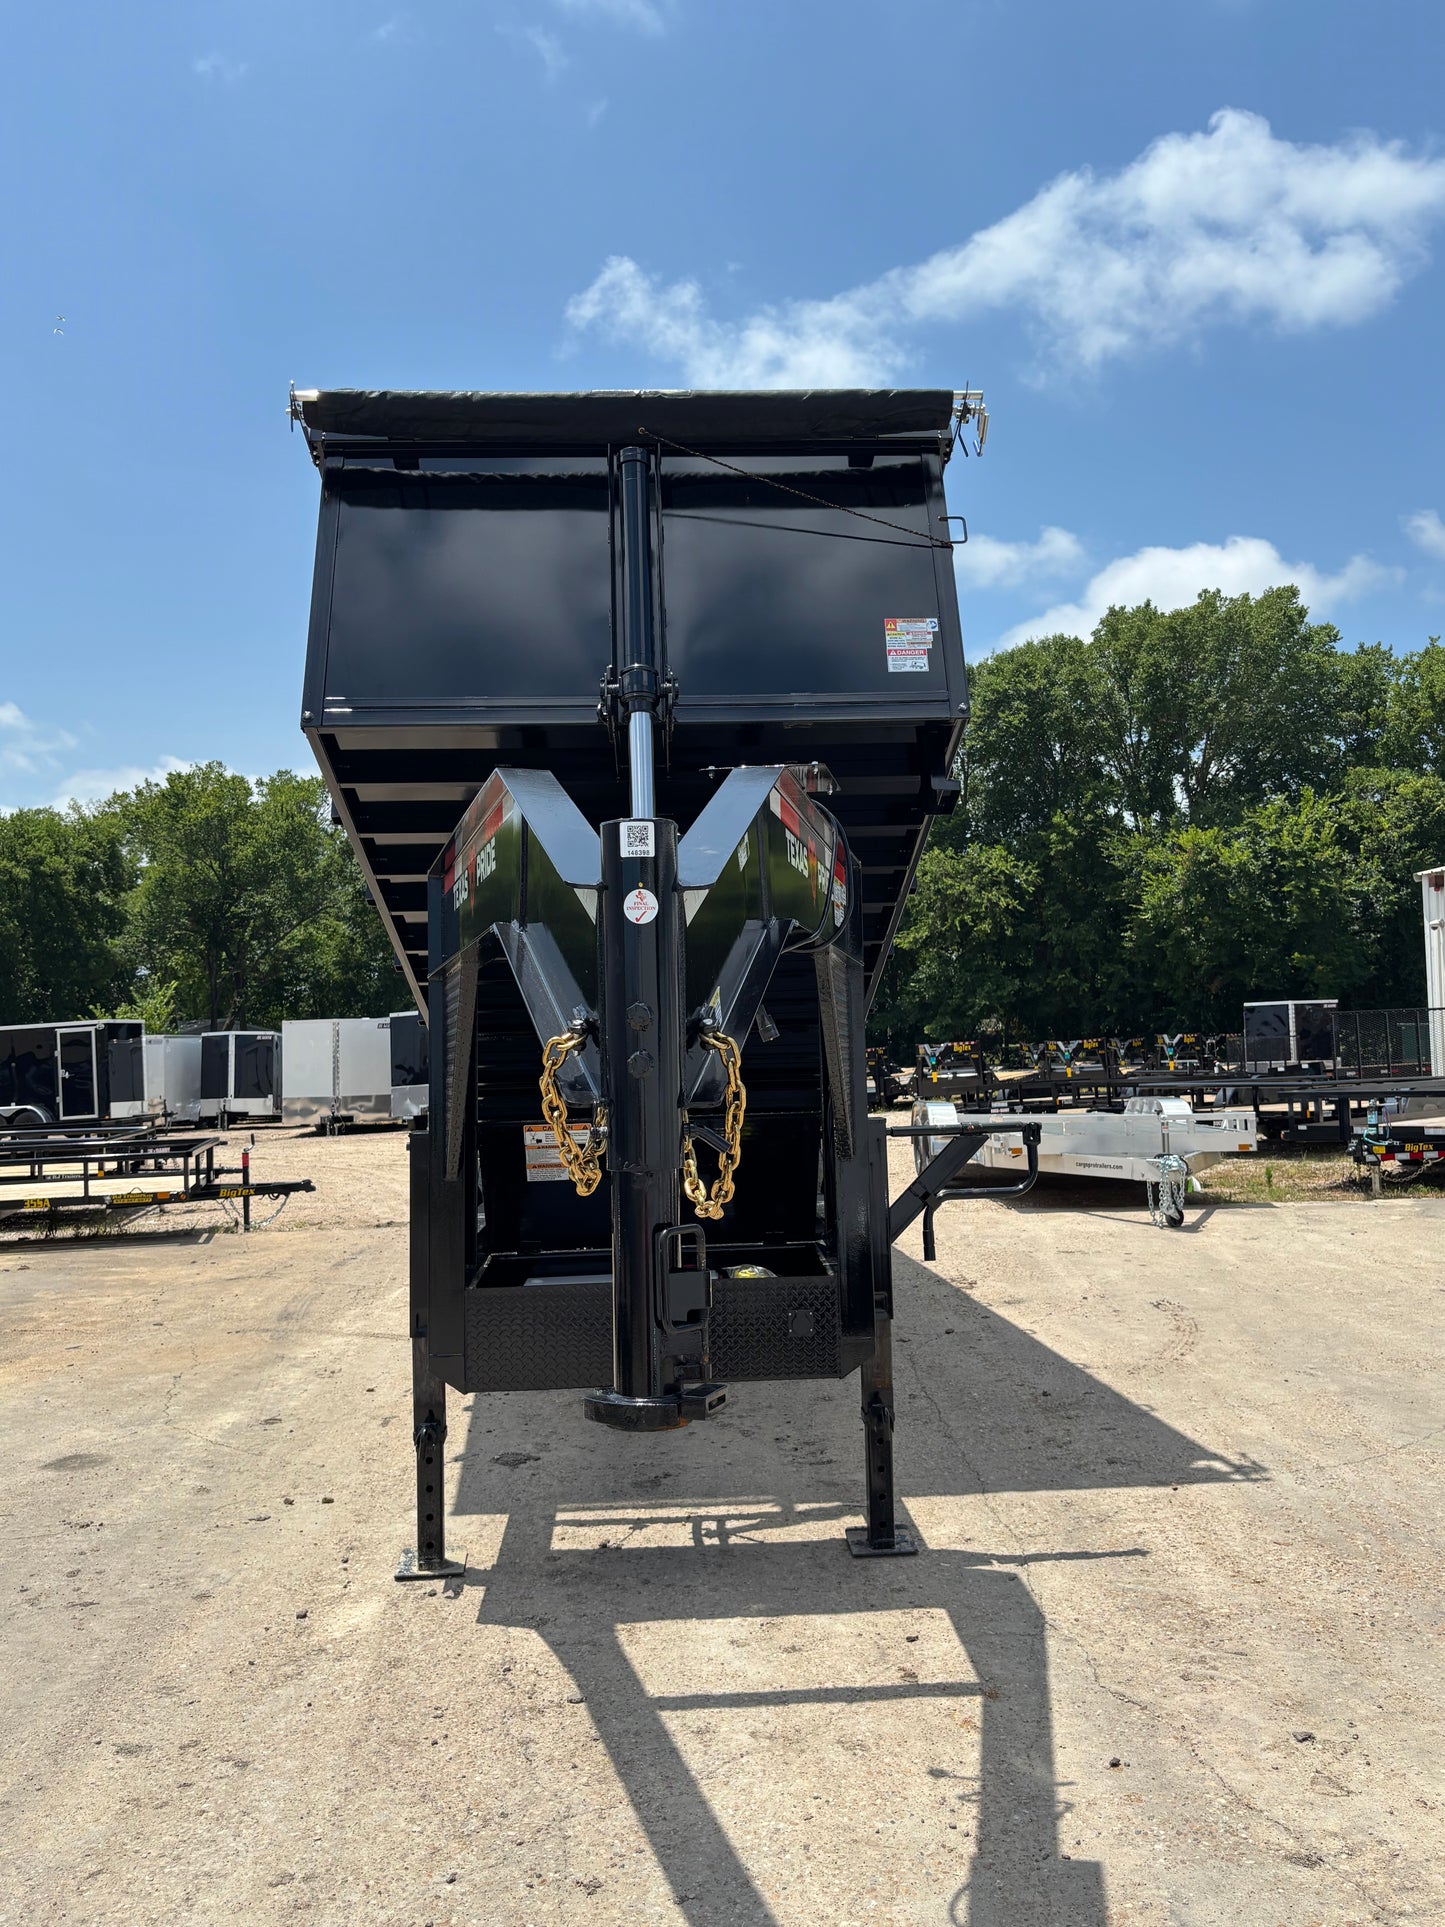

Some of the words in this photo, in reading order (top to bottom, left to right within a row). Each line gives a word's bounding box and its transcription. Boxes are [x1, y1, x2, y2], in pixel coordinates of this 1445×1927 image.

[453, 869, 469, 912] TEXAS
[476, 836, 496, 887] PRIDE
[785, 828, 808, 878] TEXAS
[817, 861, 832, 896] PRI
[1404, 1143, 1434, 1153] BigTex
[219, 1187, 256, 1198] BigTex
